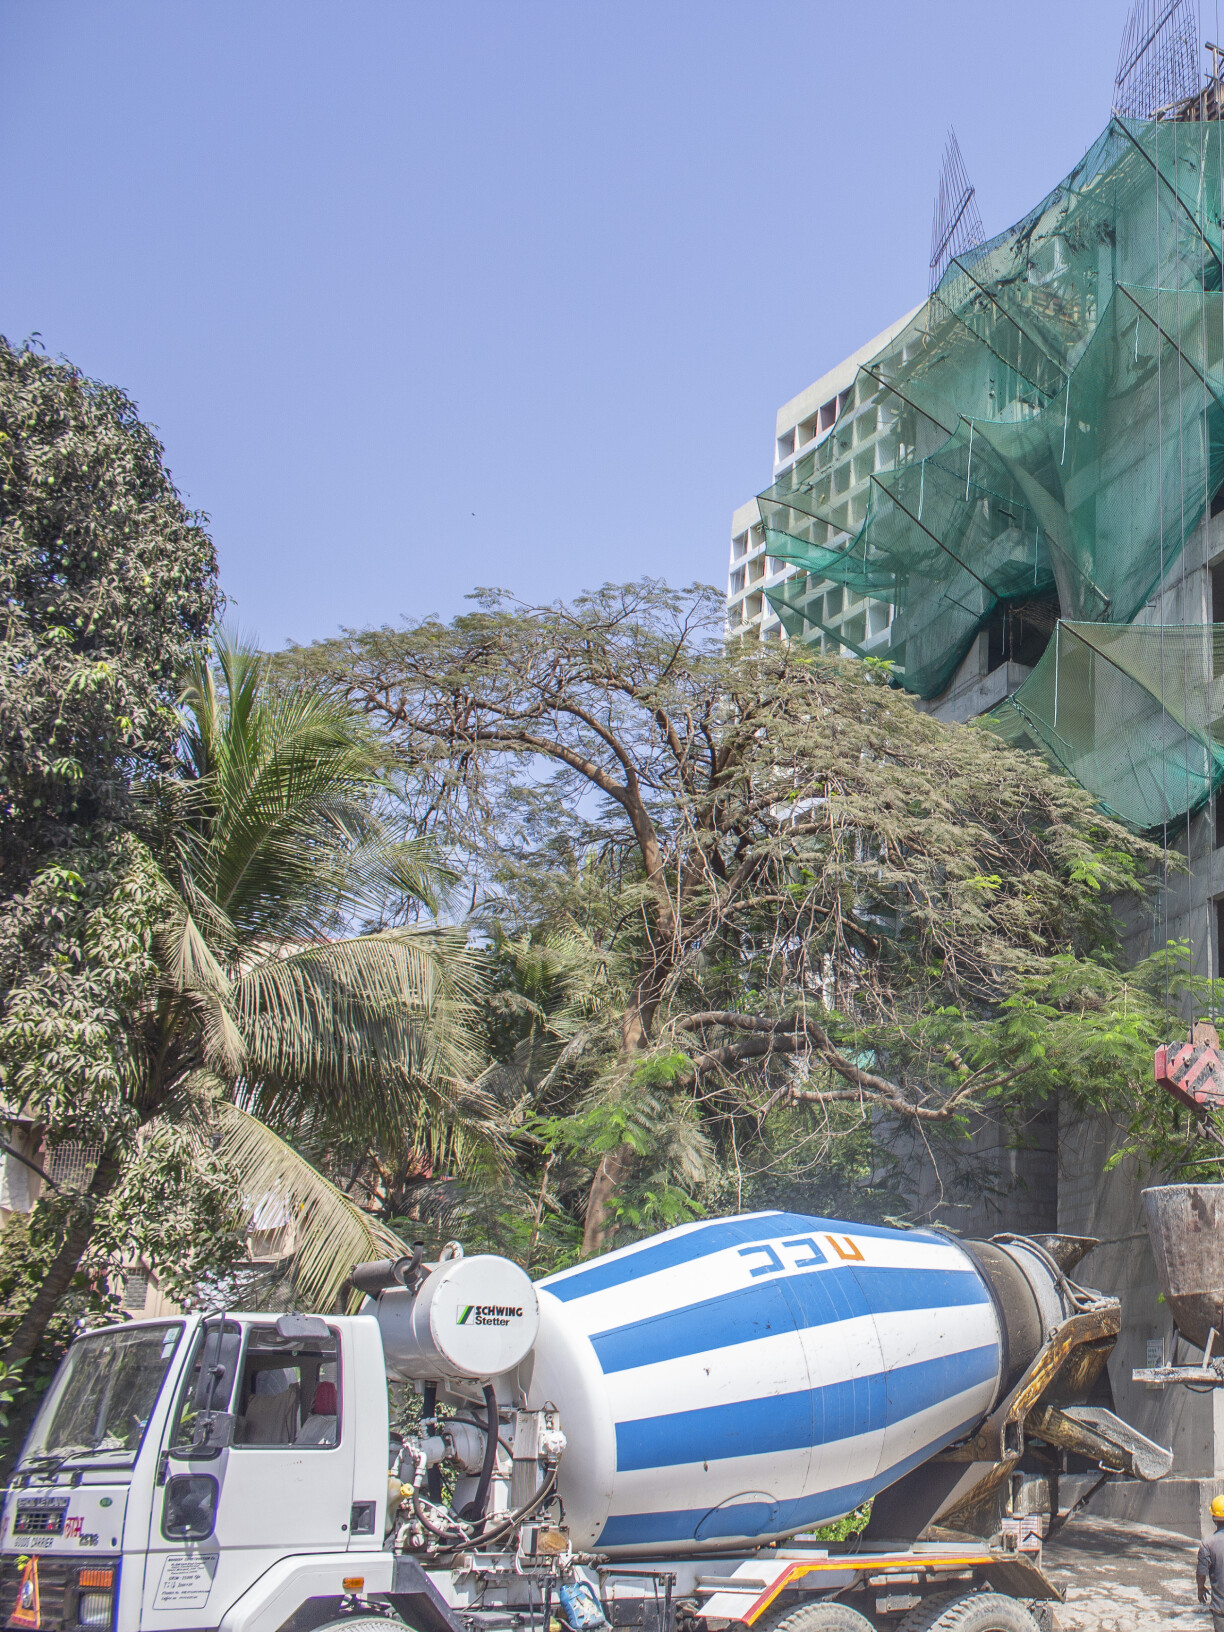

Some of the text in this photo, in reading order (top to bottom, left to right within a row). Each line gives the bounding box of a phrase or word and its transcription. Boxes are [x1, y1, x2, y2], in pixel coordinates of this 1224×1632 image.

[475, 1305, 523, 1317] SCHWING
[475, 1316, 510, 1326] Stetter
[31, 1537, 54, 1548] CARRIER
